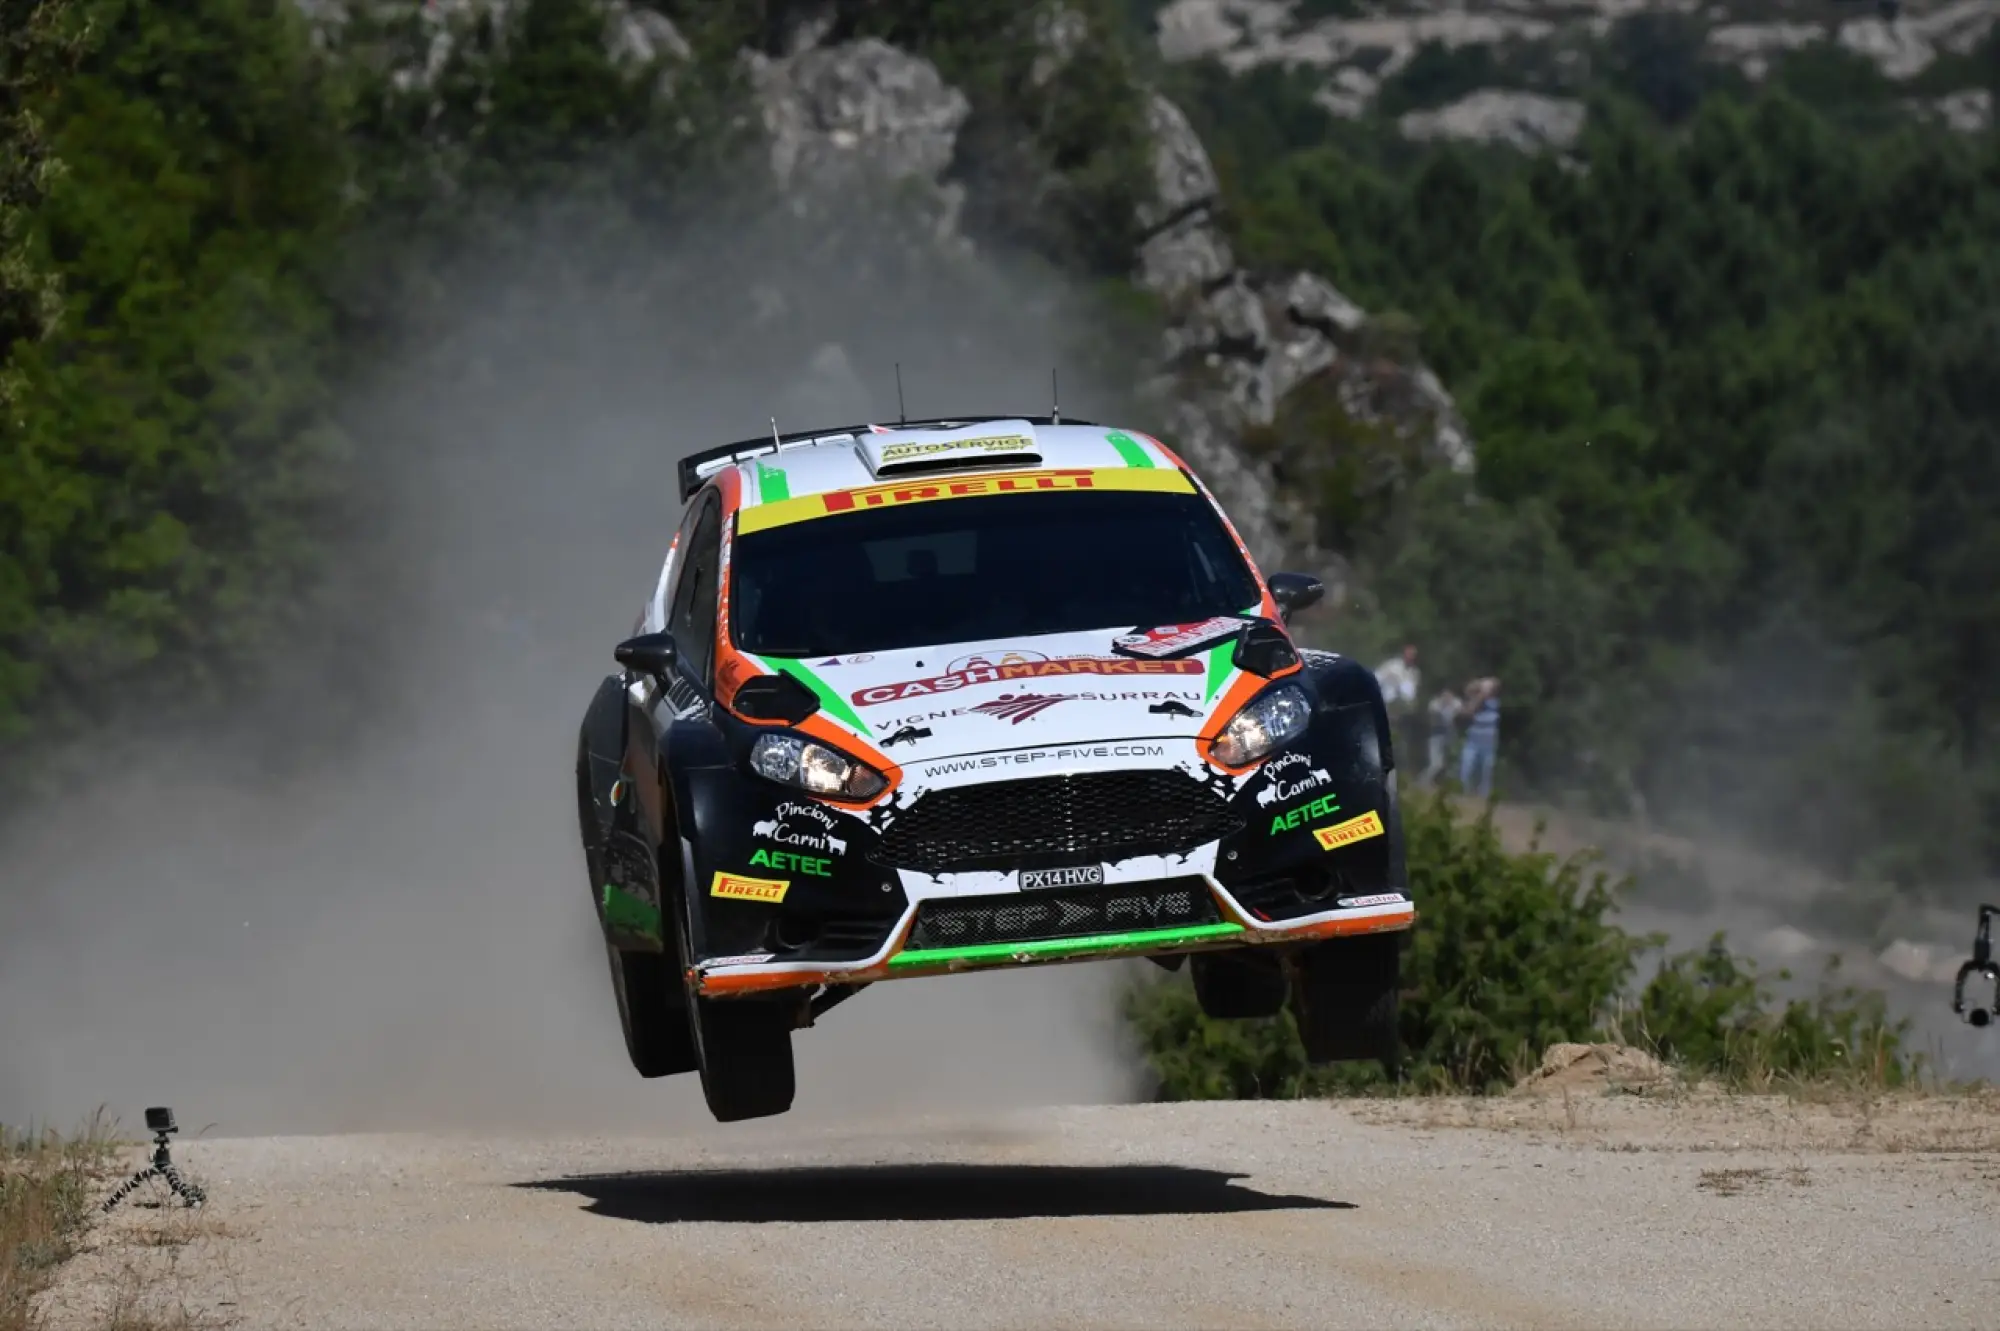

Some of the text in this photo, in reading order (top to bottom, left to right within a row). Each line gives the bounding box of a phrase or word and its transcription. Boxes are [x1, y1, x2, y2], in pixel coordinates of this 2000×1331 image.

[882, 438, 1033, 457] AUTOSERVICE
[823, 469, 1095, 512] PIRELLI
[874, 690, 1202, 731] VIGNE SURRAU
[924, 745, 1164, 777] WWW.STEP-FIVE.COM
[1264, 751, 1312, 781] Pincioni
[1276, 771, 1316, 800] Carni
[775, 801, 838, 830] Pincioni
[1270, 794, 1340, 835] AETEC
[774, 824, 826, 849] Carni
[1322, 816, 1377, 845] PIRELLI
[749, 848, 832, 877] AETEC
[1022, 866, 1101, 888] PX14 HVG
[718, 876, 782, 898] PIRELLI
[935, 903, 1049, 936] STEP
